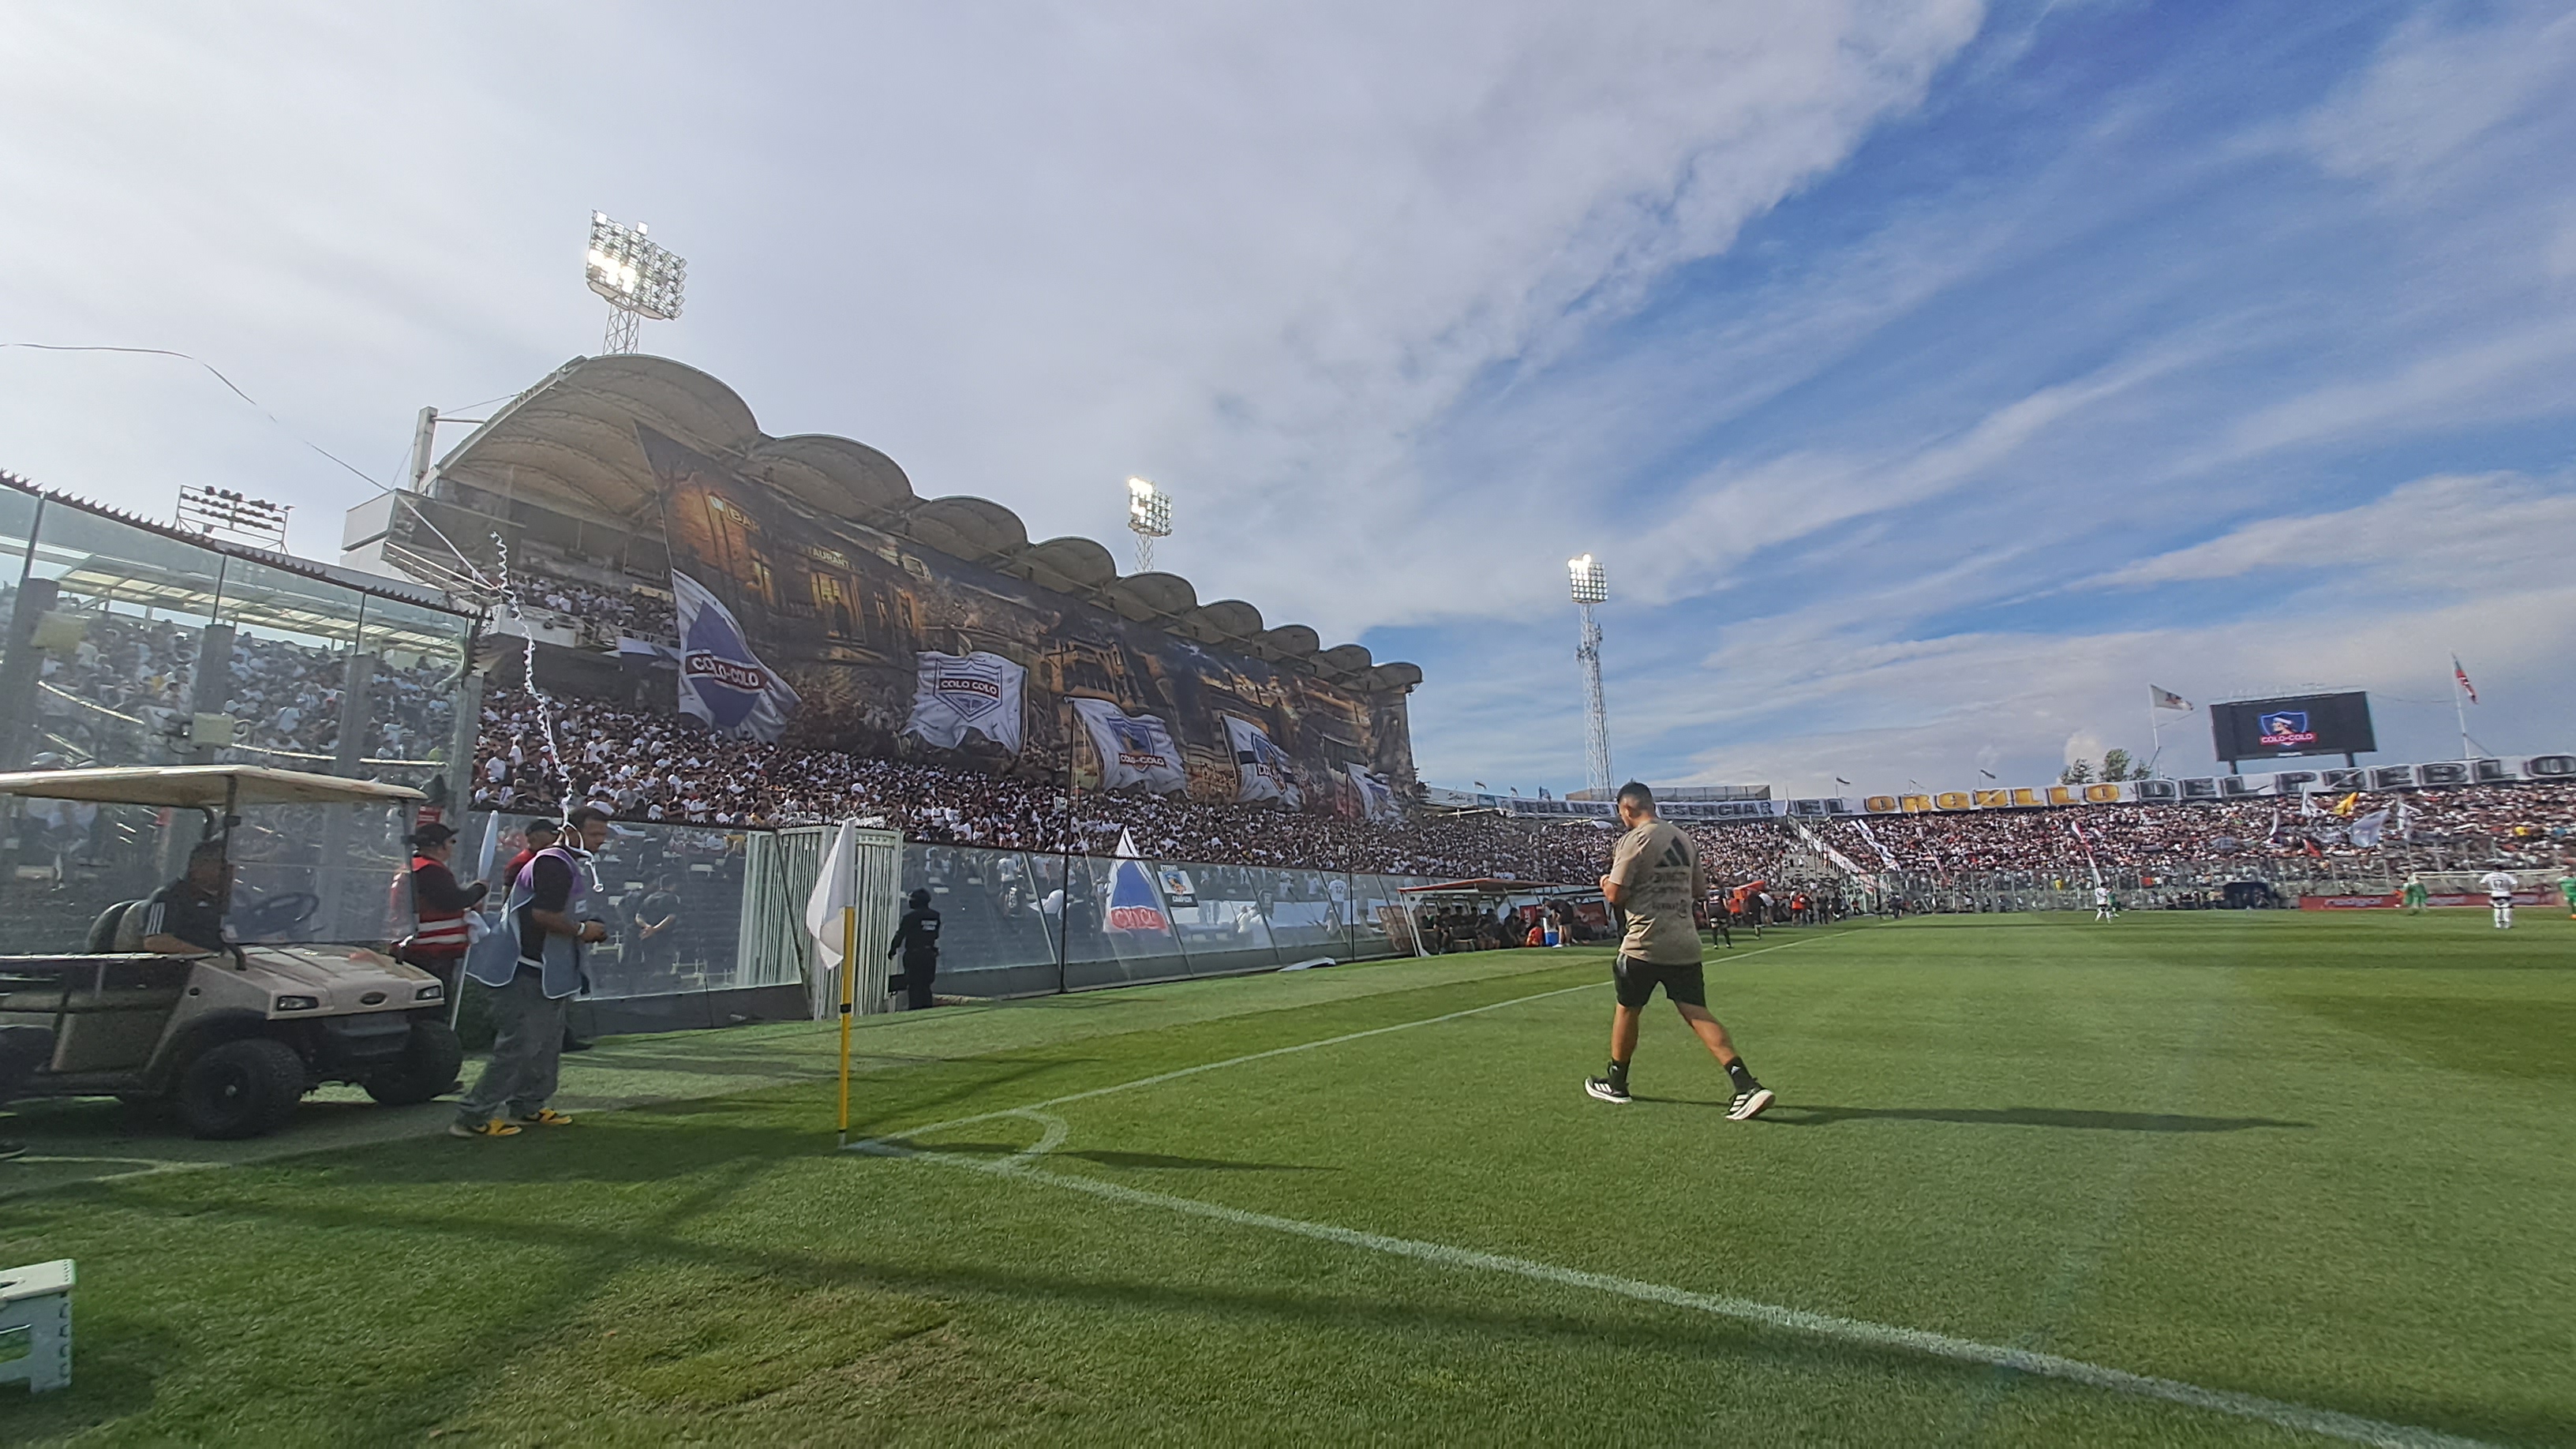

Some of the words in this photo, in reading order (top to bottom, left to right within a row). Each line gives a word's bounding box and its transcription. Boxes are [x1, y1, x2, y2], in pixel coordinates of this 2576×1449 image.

[692, 657, 759, 687] COLO-COLO
[941, 680, 969, 689] COLO
[972, 681, 998, 695] COLO
[2260, 733, 2313, 743] COLO-COLO
[1794, 798, 1852, 815] EL
[1864, 784, 2120, 814] ORGULLO
[2134, 777, 2270, 799] DEL
[2275, 755, 2576, 794] PUEBLO
[1661, 803, 1759, 817] ESENCIA
